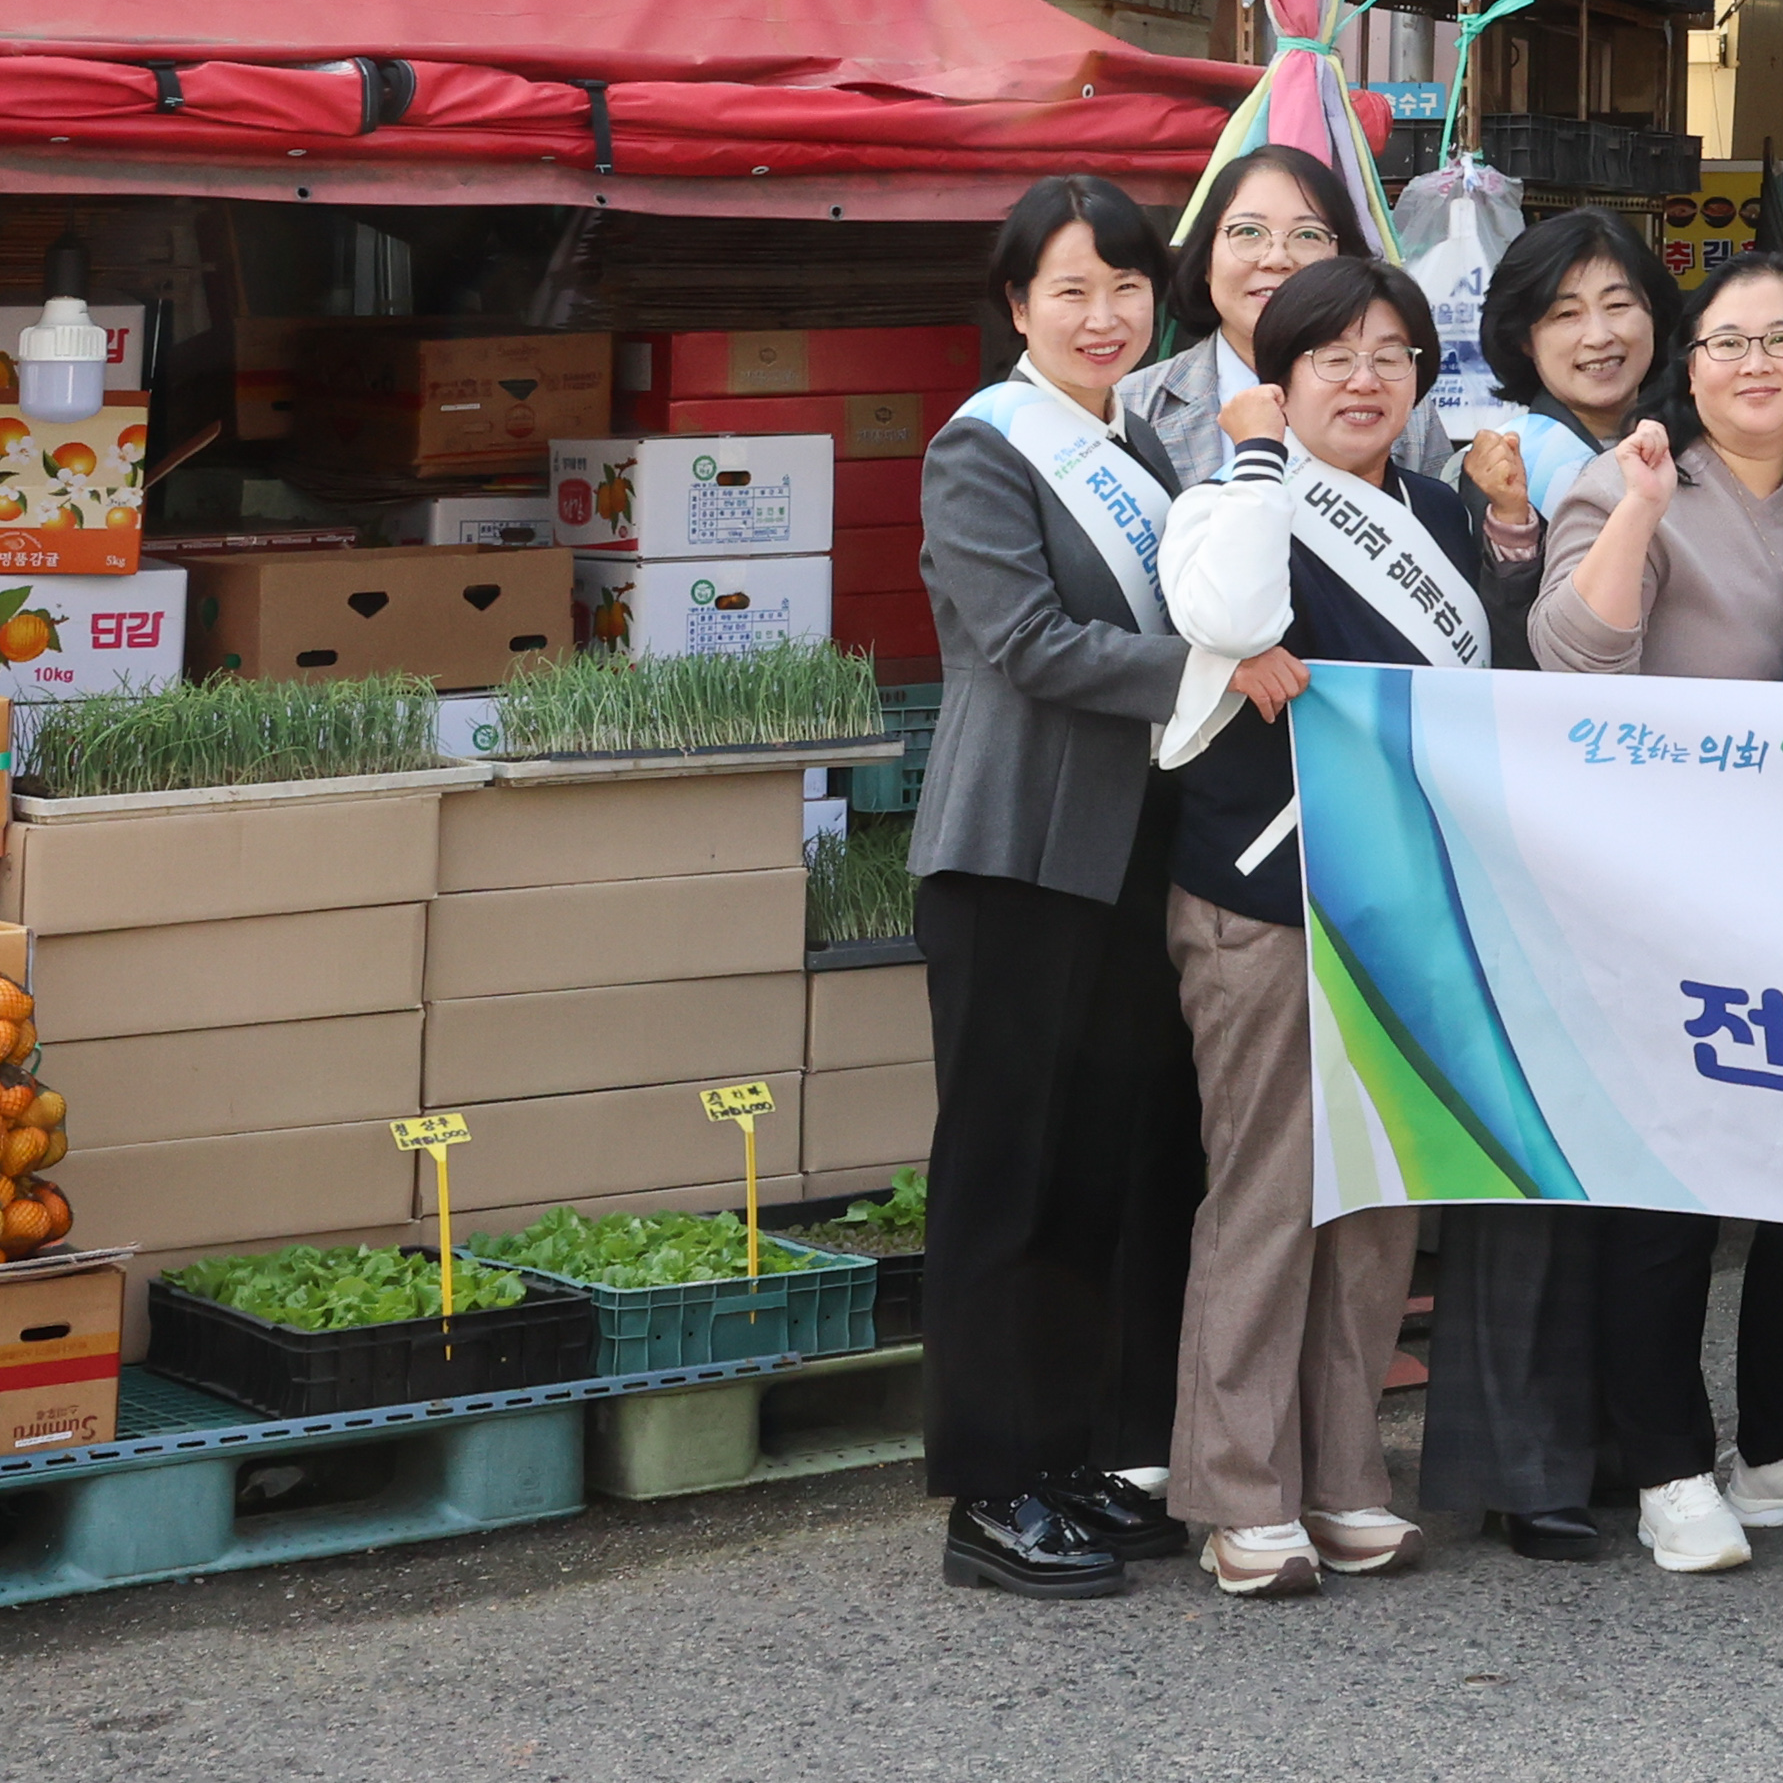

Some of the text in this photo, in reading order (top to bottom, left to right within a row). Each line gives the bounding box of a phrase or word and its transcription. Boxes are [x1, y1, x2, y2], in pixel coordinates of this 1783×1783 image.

[105, 554, 127, 569] 5kg
[1304, 480, 1479, 666] 도민과 함께하는
[90, 611, 165, 650] 단감
[33, 666, 75, 685] 10kg
[1568, 717, 1617, 765] 일
[1616, 723, 1692, 766] 잘하는
[1699, 730, 1769, 774] 의회
